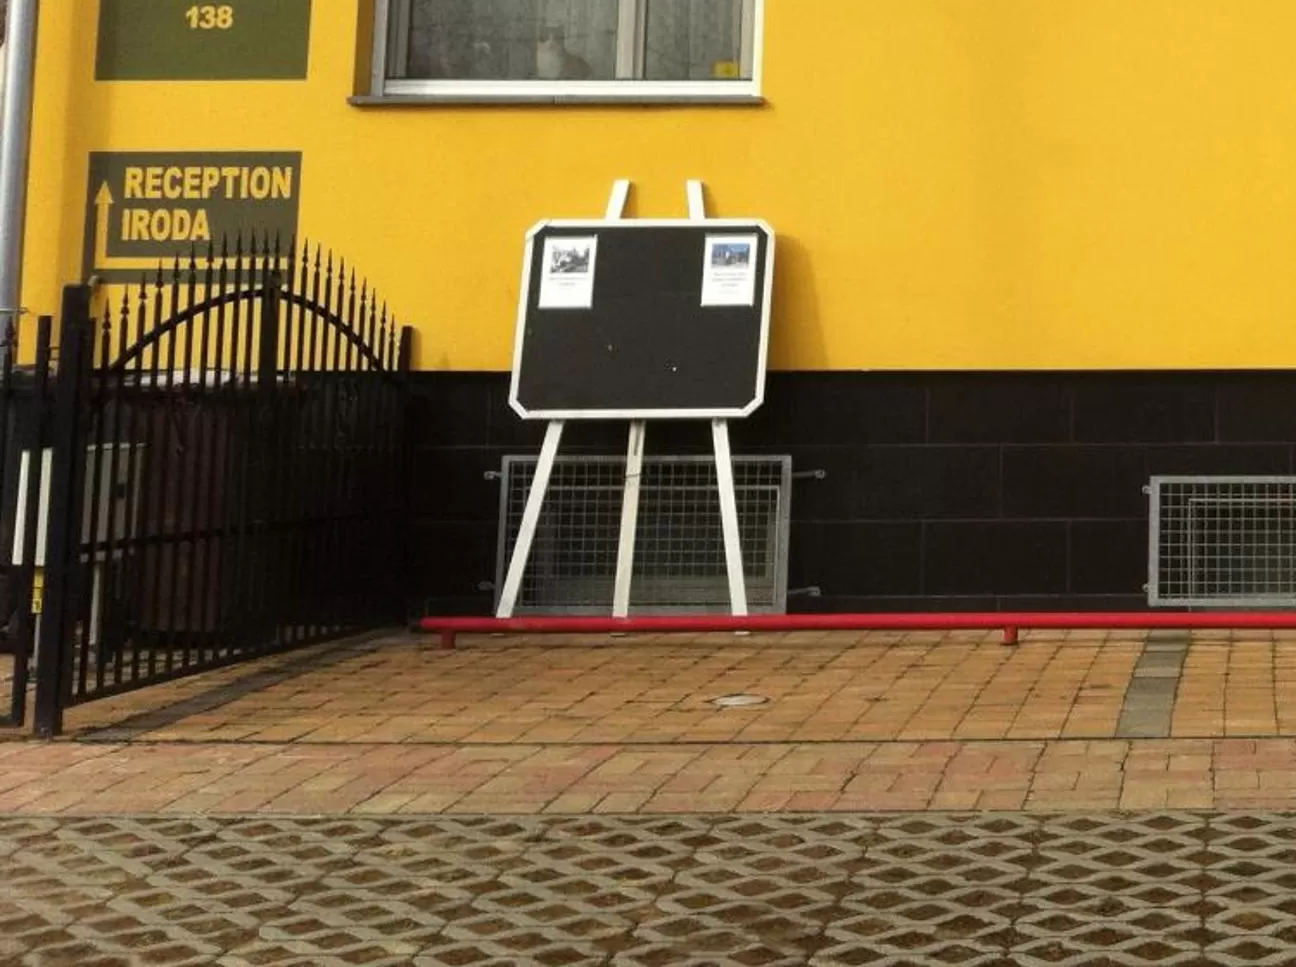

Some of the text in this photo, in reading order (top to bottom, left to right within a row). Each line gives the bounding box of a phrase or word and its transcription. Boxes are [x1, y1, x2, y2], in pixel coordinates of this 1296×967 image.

[186, 5, 234, 29] 138
[124, 166, 293, 199] RECEPTION
[121, 208, 211, 241] IRODA
